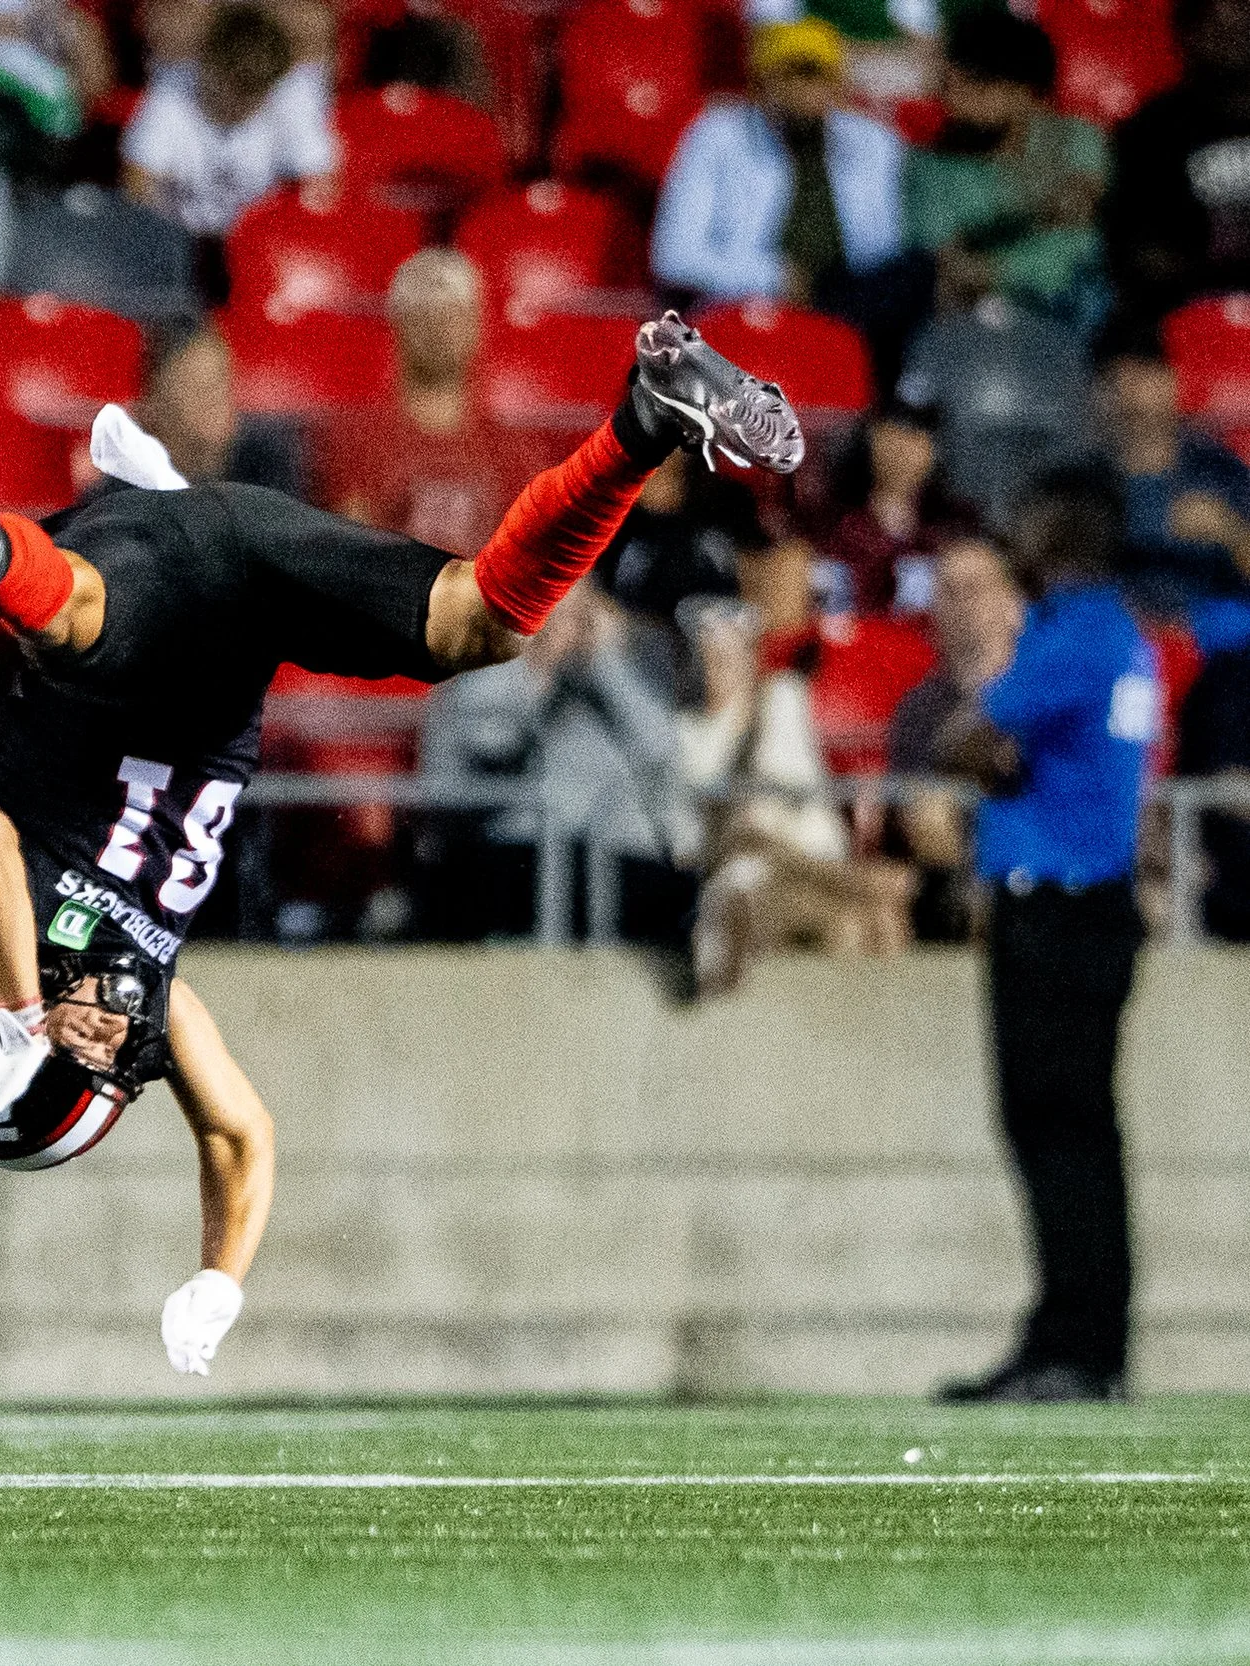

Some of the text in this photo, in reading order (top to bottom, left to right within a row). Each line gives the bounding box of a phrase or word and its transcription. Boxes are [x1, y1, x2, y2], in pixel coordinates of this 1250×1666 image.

[96, 754, 244, 914] 81
[54, 868, 183, 966] REDBLACKS
[55, 909, 90, 938] TD
